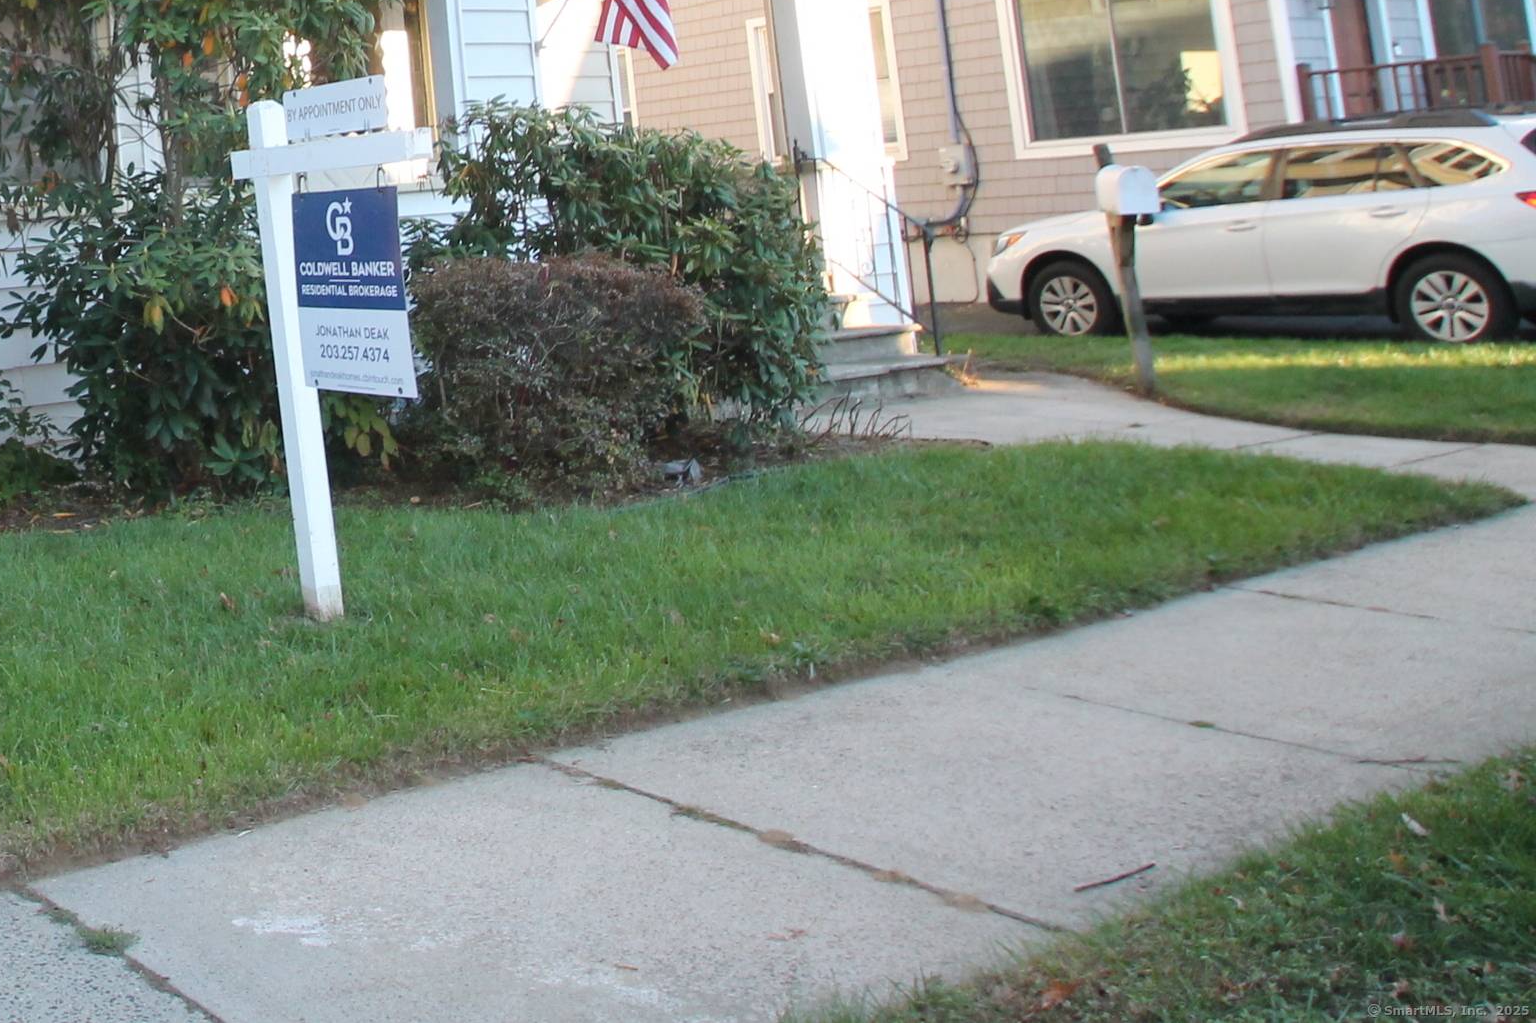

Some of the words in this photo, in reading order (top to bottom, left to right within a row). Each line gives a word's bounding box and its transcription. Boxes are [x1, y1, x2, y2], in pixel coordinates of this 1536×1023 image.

[287, 108, 297, 122] BY
[298, 98, 356, 121] APPOINTMENT
[358, 94, 382, 111] ONLY
[299, 261, 349, 277] COLDWELL
[351, 261, 395, 277] BANKER
[301, 285, 347, 297] RESIDENTIAL
[348, 285, 398, 298] BROKERAGE
[315, 324, 361, 339] JONATHAN
[363, 326, 390, 341] DEAK
[320, 344, 390, 363] 203.257.4374
